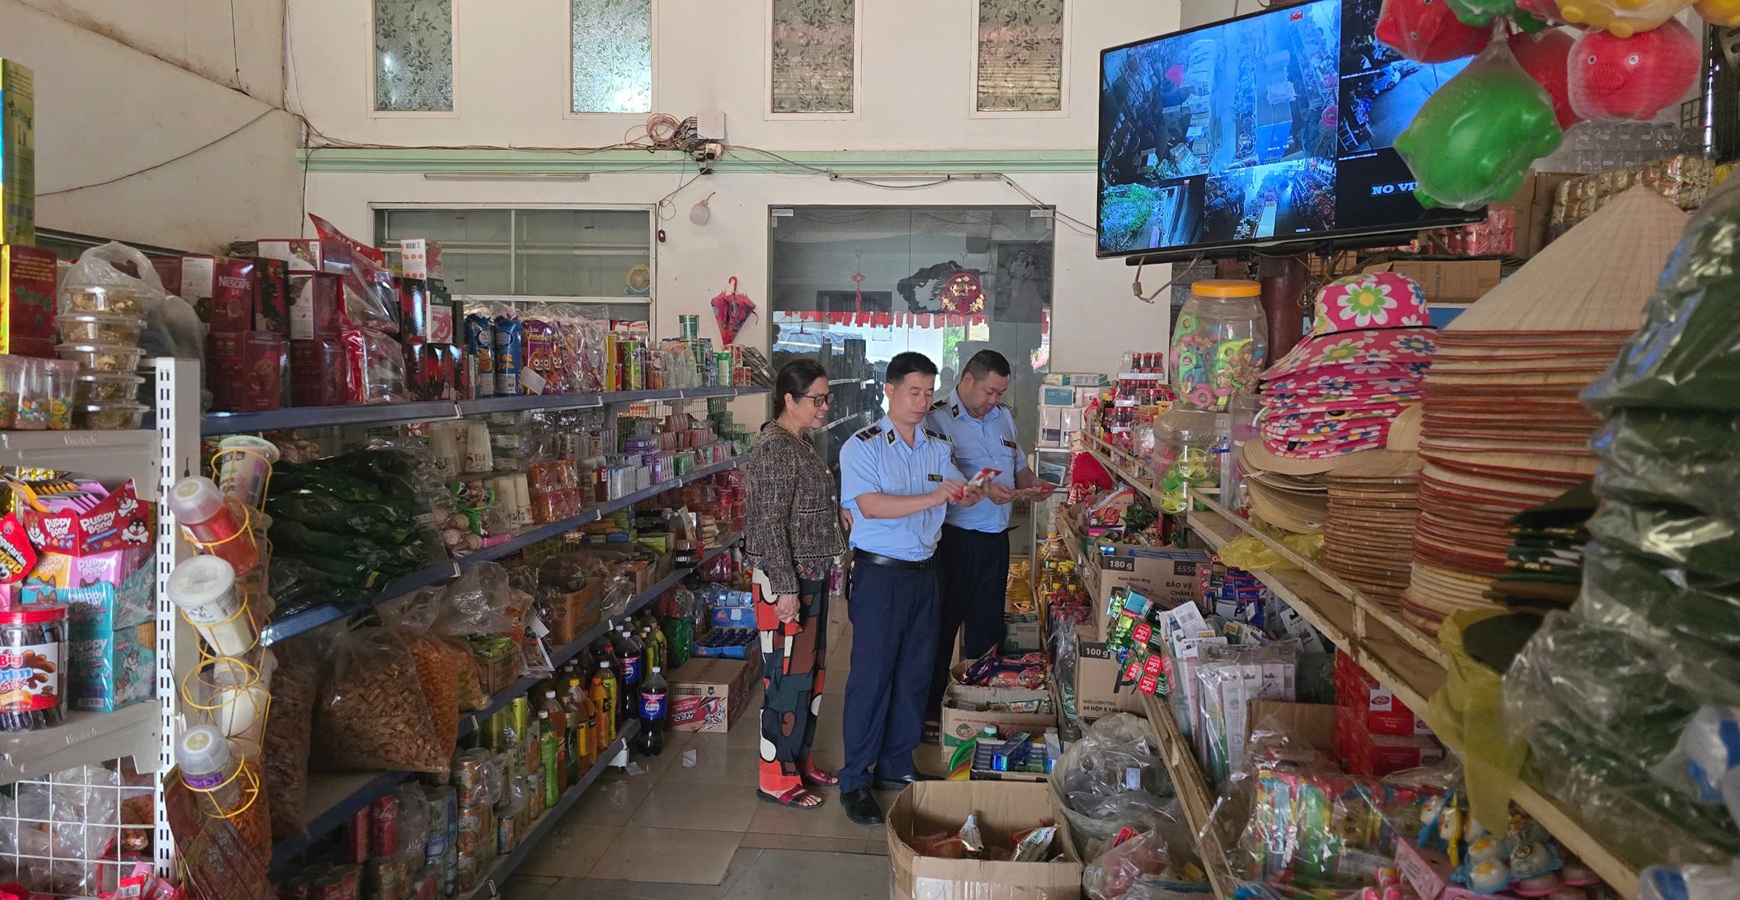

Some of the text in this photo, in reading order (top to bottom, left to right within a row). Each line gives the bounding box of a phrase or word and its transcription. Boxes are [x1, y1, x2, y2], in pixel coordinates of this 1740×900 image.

[1371, 181, 1419, 195] NO VI
[1109, 560, 1133, 570] 180 g
[1166, 580, 1181, 588] BẢO
[1085, 648, 1101, 656] 100
